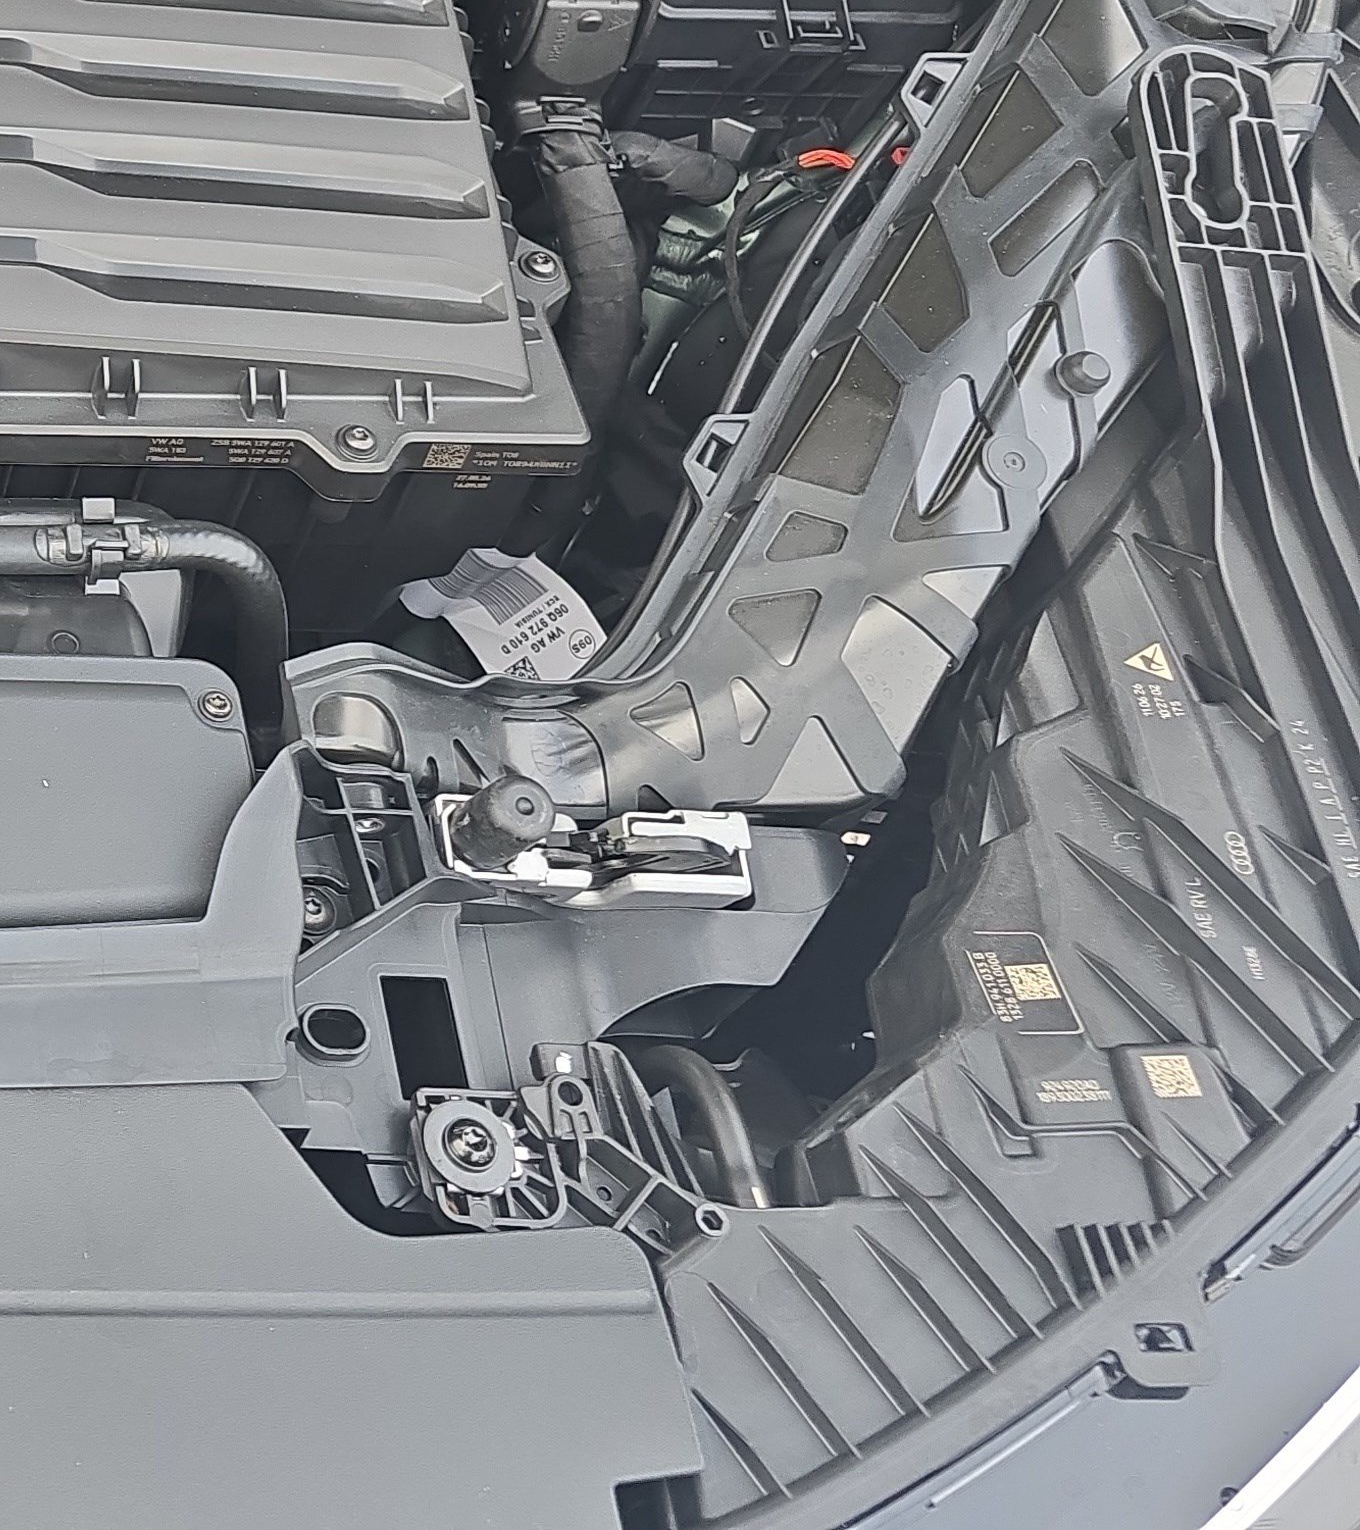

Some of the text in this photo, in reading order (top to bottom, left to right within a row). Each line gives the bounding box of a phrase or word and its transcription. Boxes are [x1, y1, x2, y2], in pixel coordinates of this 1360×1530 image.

[474, 451, 500, 459] Spain
[500, 603, 570, 656] 06Q 972 610 D
[513, 606, 544, 630] TUNISIA
[530, 626, 566, 654] VW AG
[571, 636, 593, 655] 09S
[1187, 889, 1208, 908] RV
[1193, 913, 1217, 938] SAE
